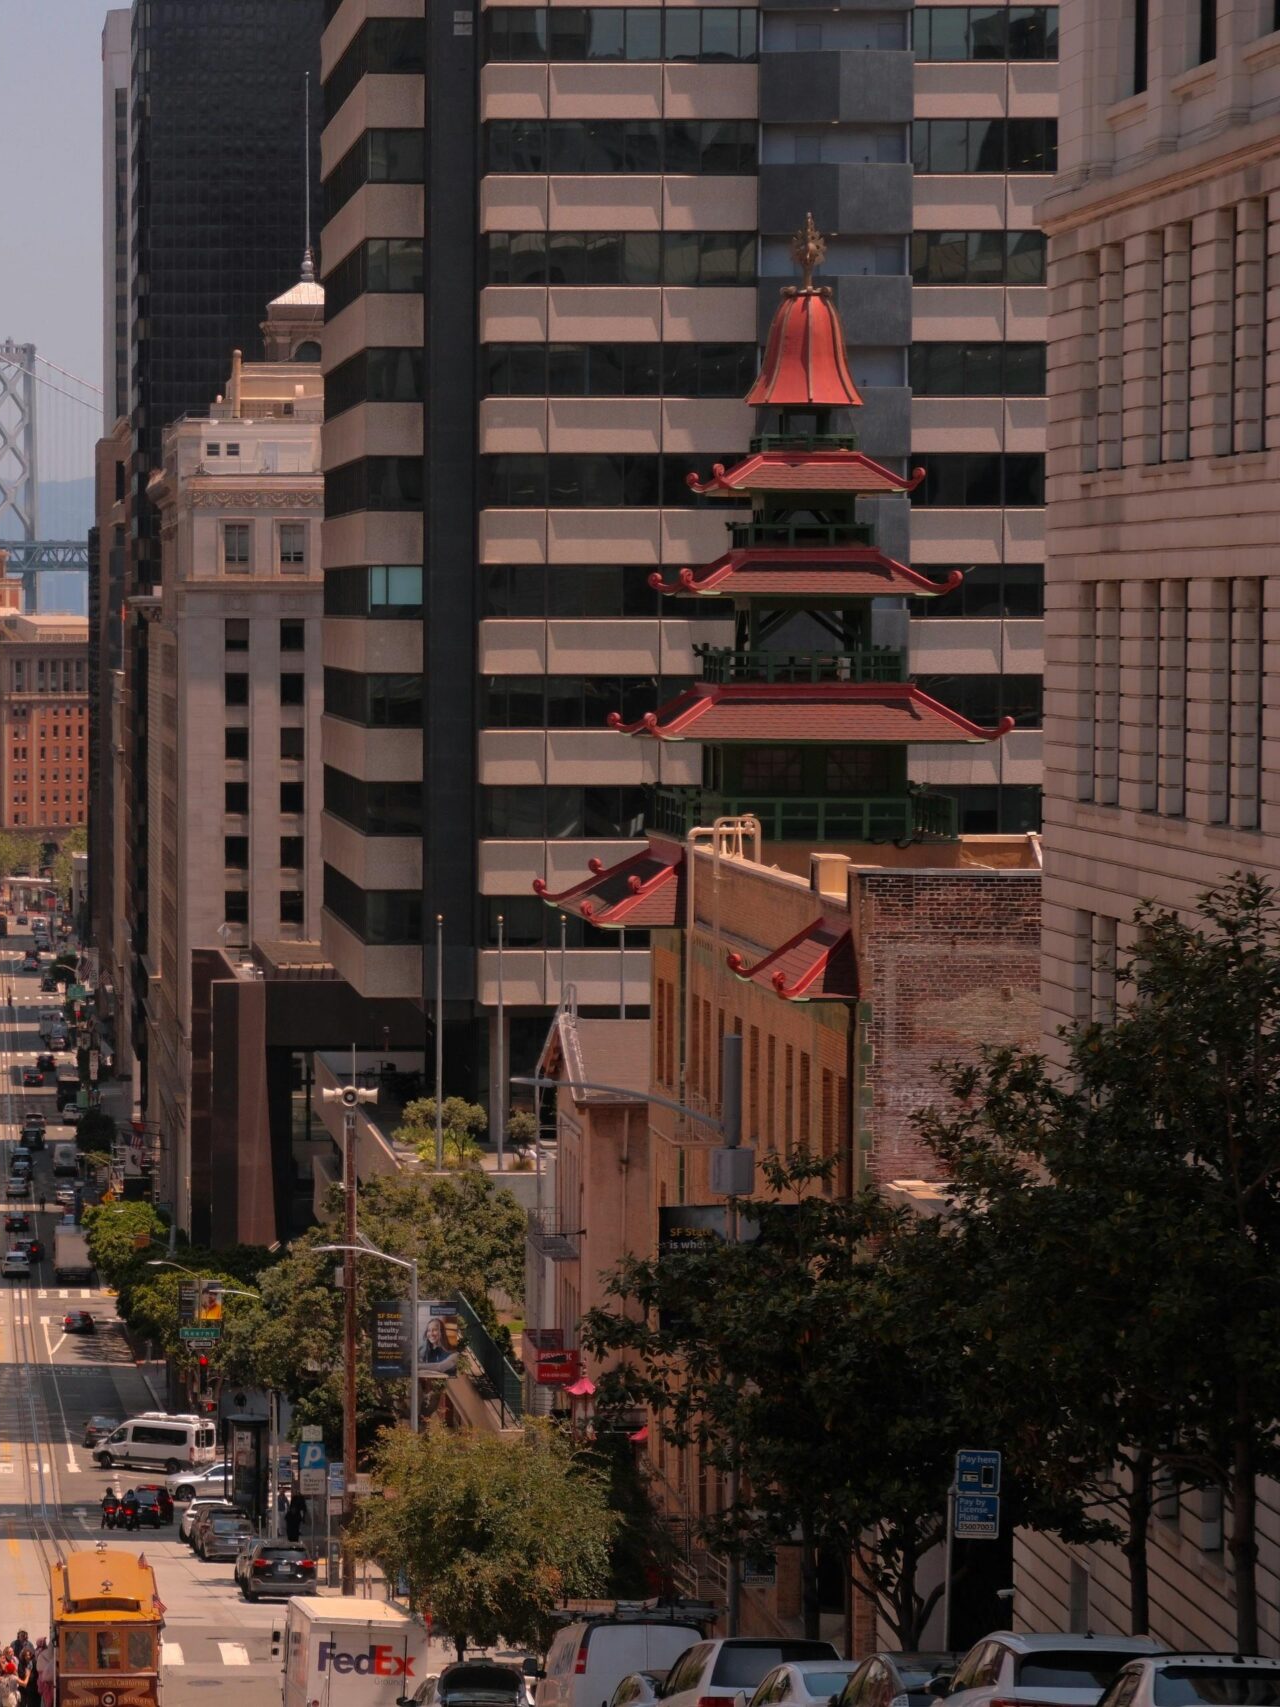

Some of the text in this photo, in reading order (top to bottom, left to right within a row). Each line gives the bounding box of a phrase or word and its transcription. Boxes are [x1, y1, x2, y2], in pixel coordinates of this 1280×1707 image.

[670, 1228, 683, 1237] SF
[670, 1240, 678, 1249] is
[960, 1455, 998, 1464] Pay here
[959, 1498, 986, 1506] Pay by
[959, 1505, 988, 1513] License
[318, 1642, 416, 1677] FedEx
